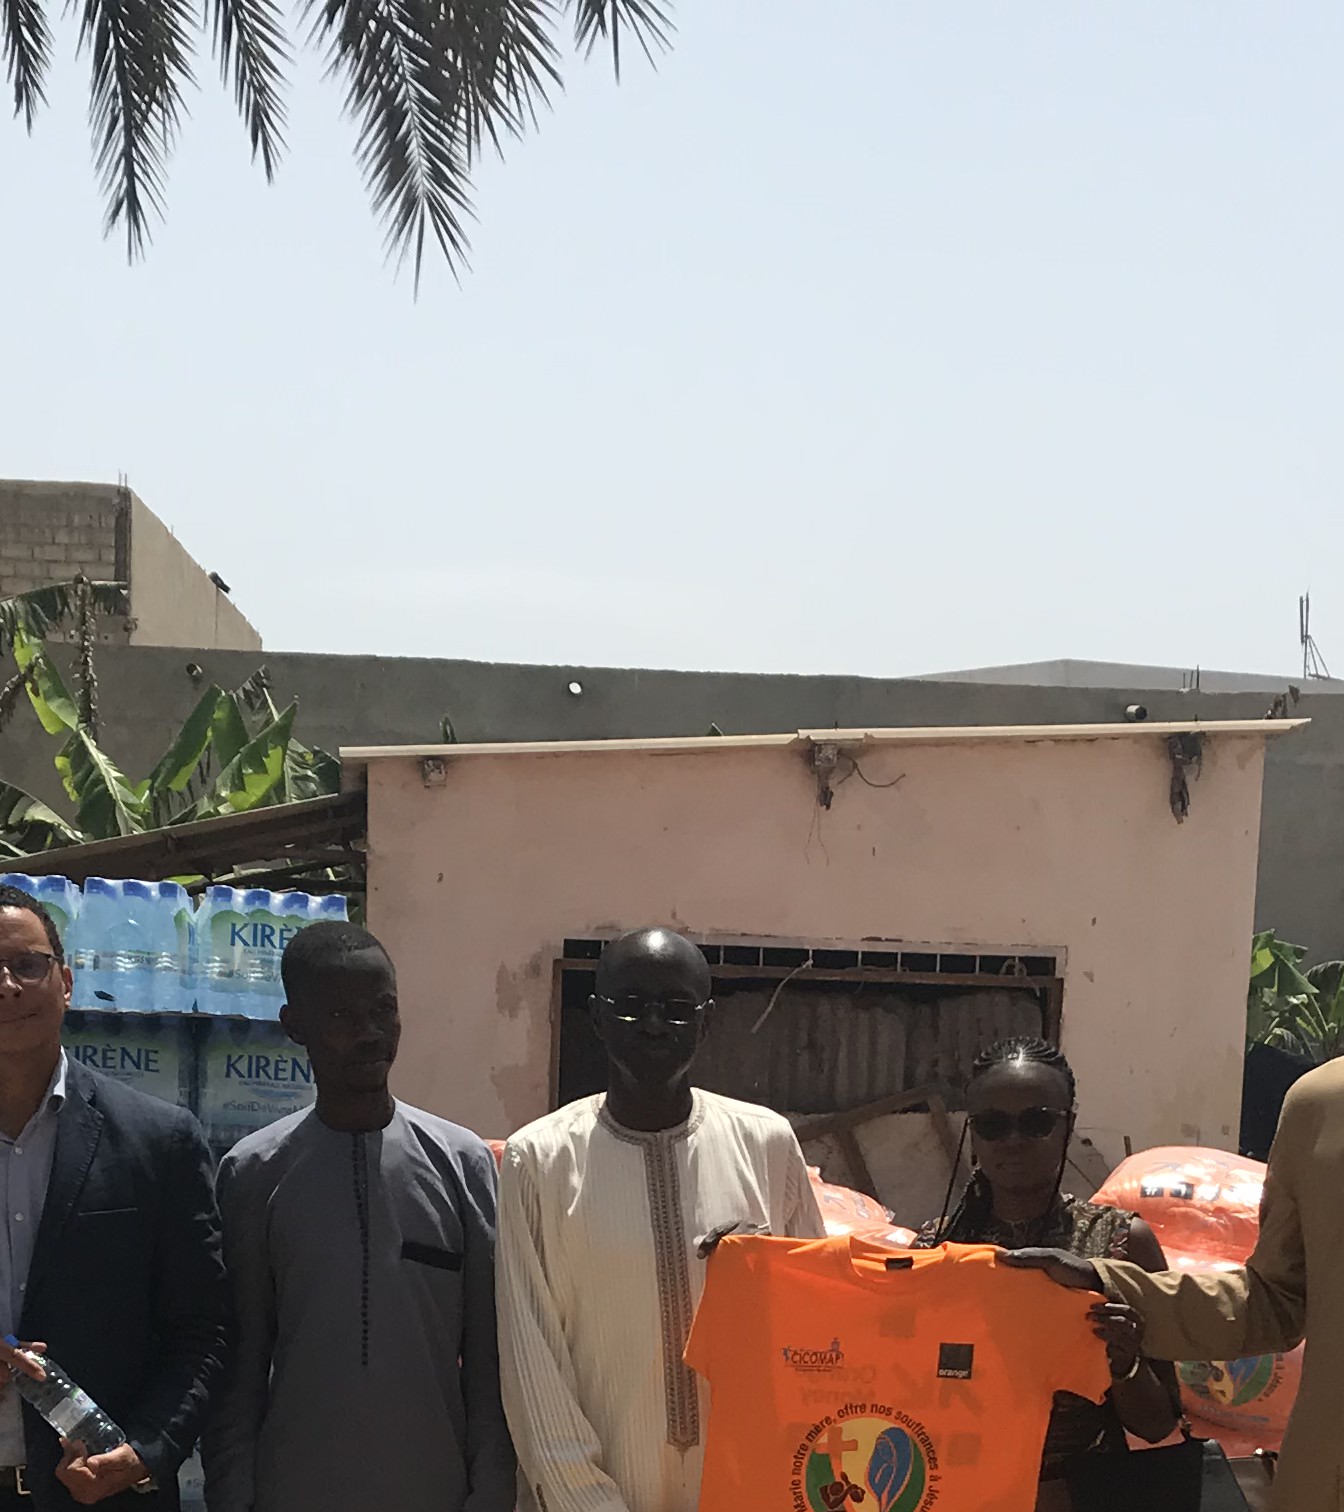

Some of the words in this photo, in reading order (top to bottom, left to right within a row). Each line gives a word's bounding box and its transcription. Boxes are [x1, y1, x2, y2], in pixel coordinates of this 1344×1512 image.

[230, 922, 303, 949] KIRÈ
[65, 1045, 160, 1073] IRÈNE
[938, 1368, 969, 1379] orange
[792, 1442, 809, 1477] notre
[837, 1402, 867, 1419] offre
[870, 1403, 893, 1417] nos
[894, 1410, 939, 1471] souffrances
